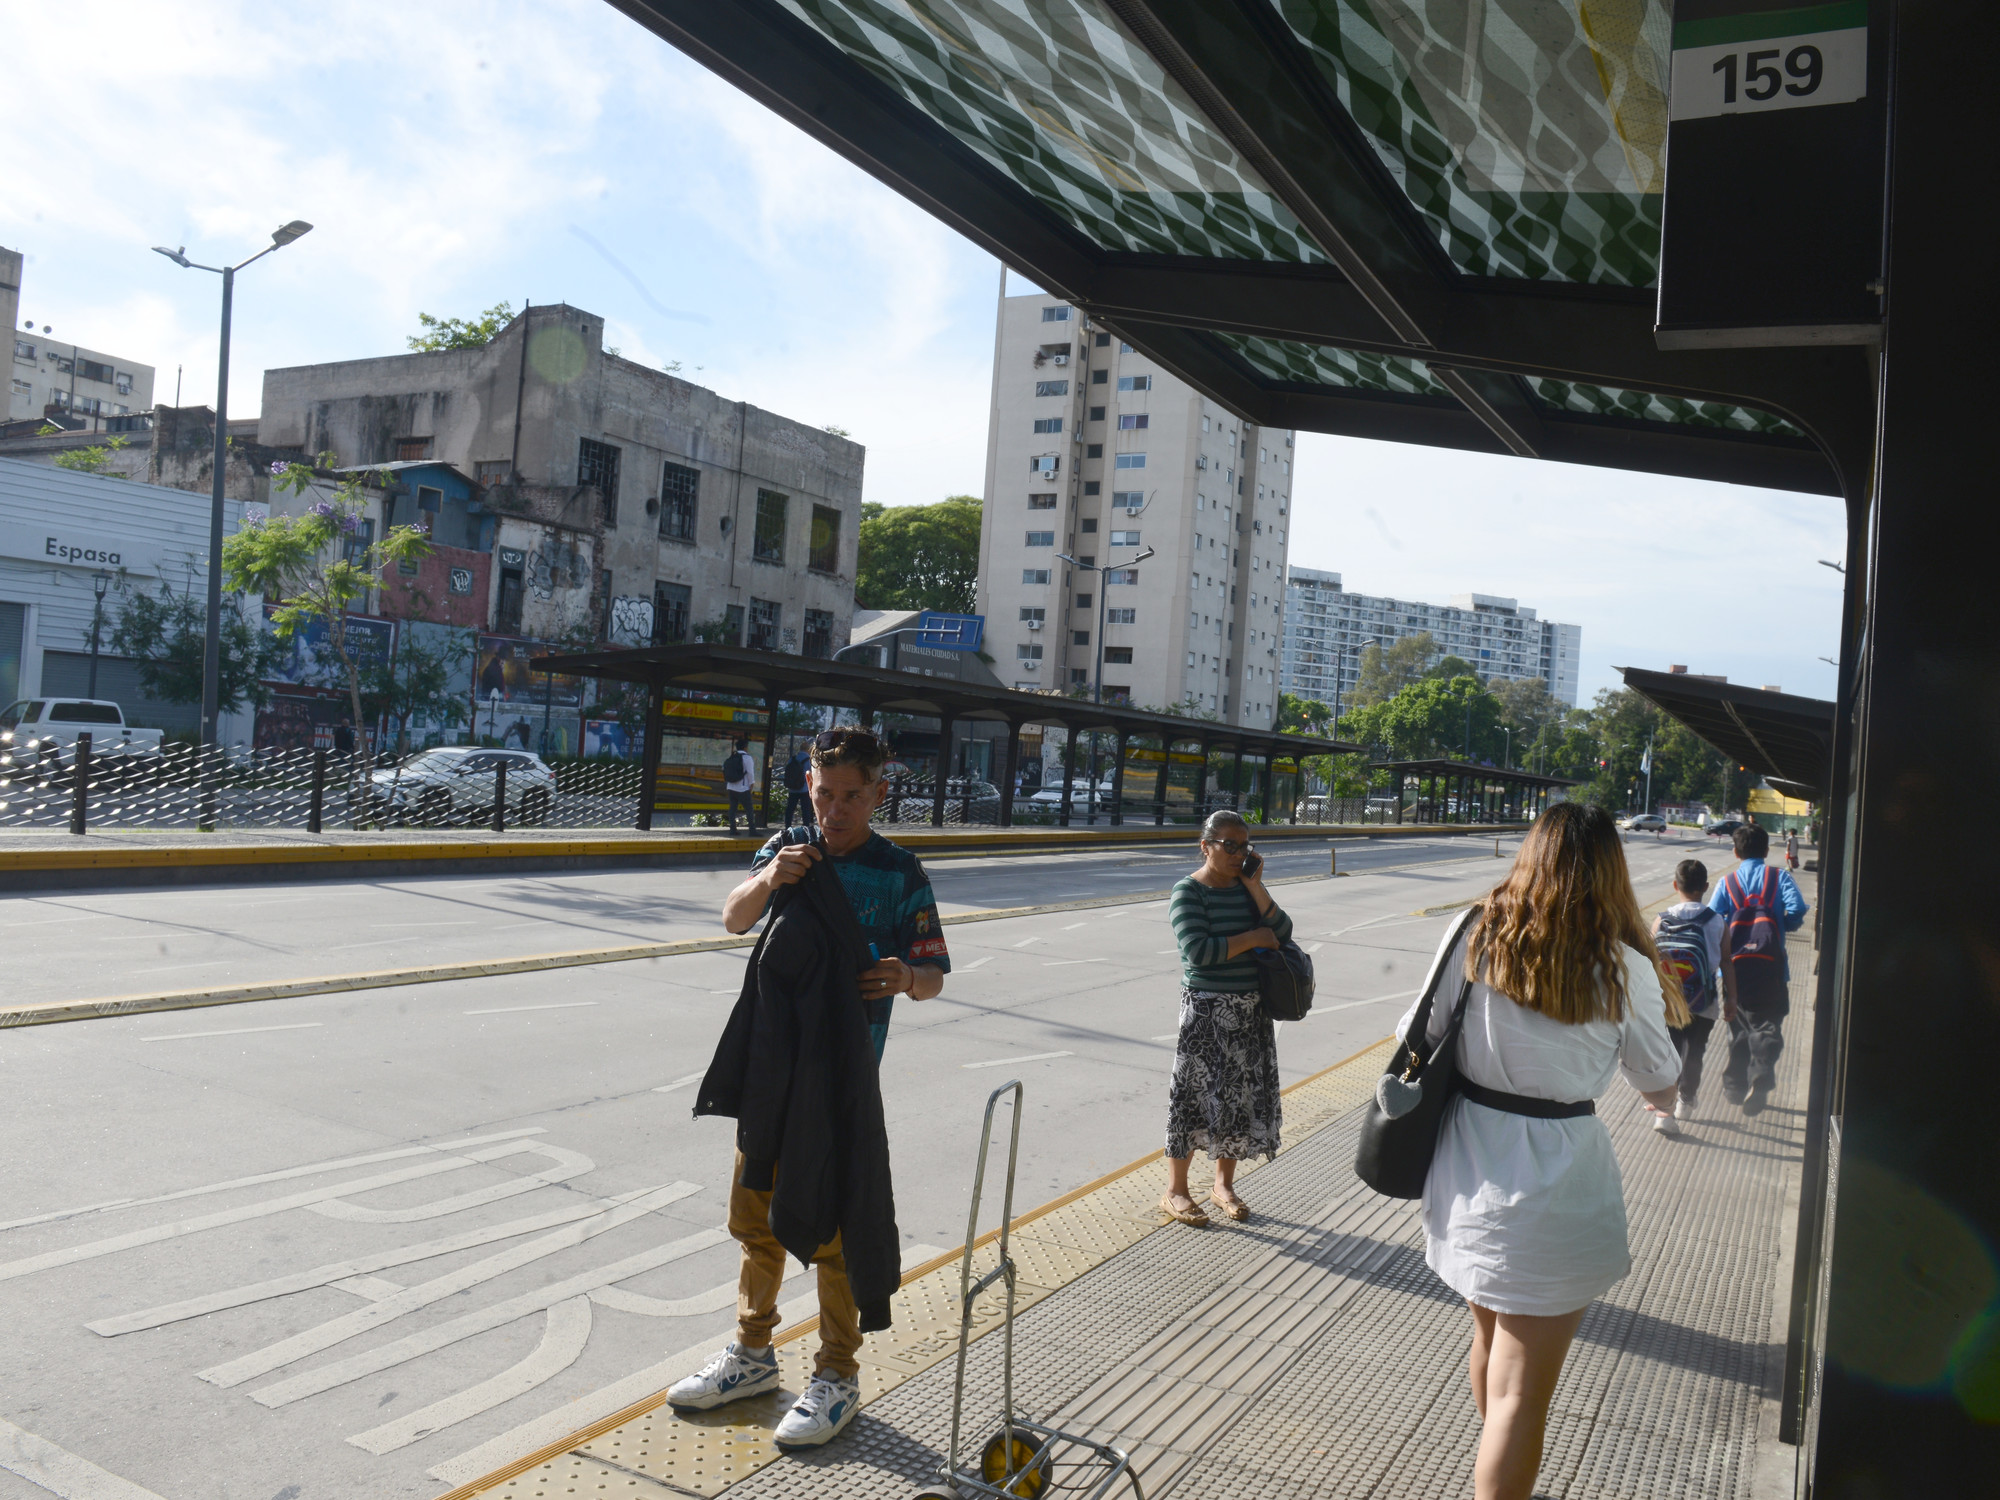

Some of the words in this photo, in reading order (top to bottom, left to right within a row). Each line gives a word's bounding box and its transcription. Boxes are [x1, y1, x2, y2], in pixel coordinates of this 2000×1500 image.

[1712, 45, 1823, 103] 159
[45, 536, 121, 565] Espasa
[900, 643, 931, 656] MATERIALES
[931, 648, 951, 659] CIUDAD
[694, 705, 723, 718] Lezama
